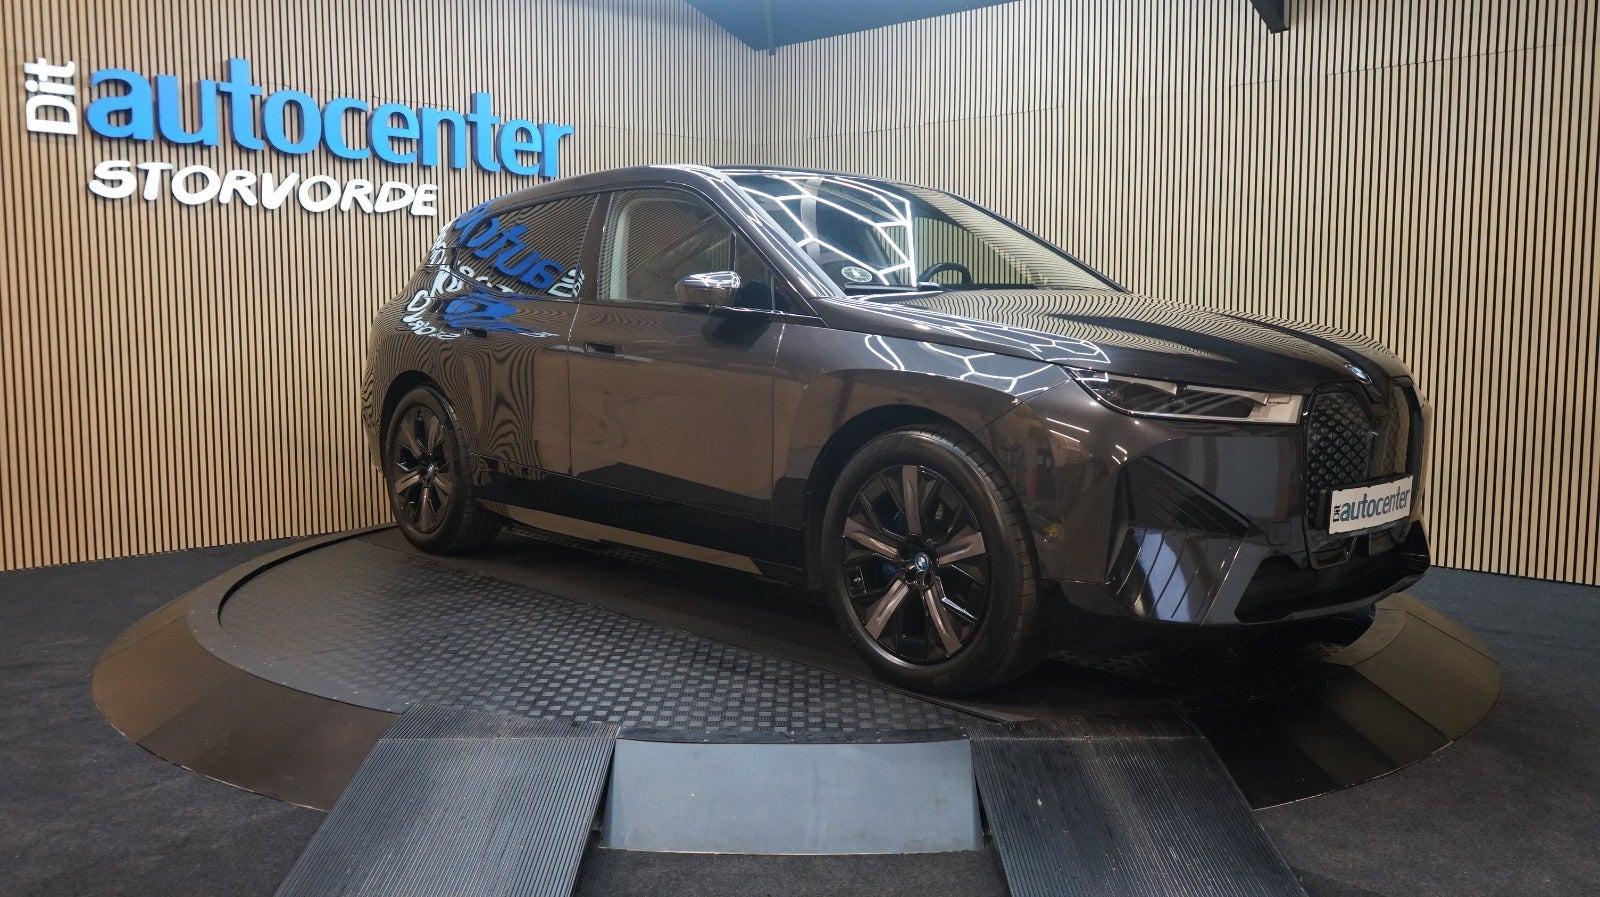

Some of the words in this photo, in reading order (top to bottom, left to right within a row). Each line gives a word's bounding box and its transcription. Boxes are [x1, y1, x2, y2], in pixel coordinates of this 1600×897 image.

[24, 57, 78, 135] Dit
[86, 57, 575, 178] autocenter
[88, 160, 438, 217] STORVORDE
[1332, 504, 1341, 523] Dit
[1340, 486, 1410, 522] autocenter
